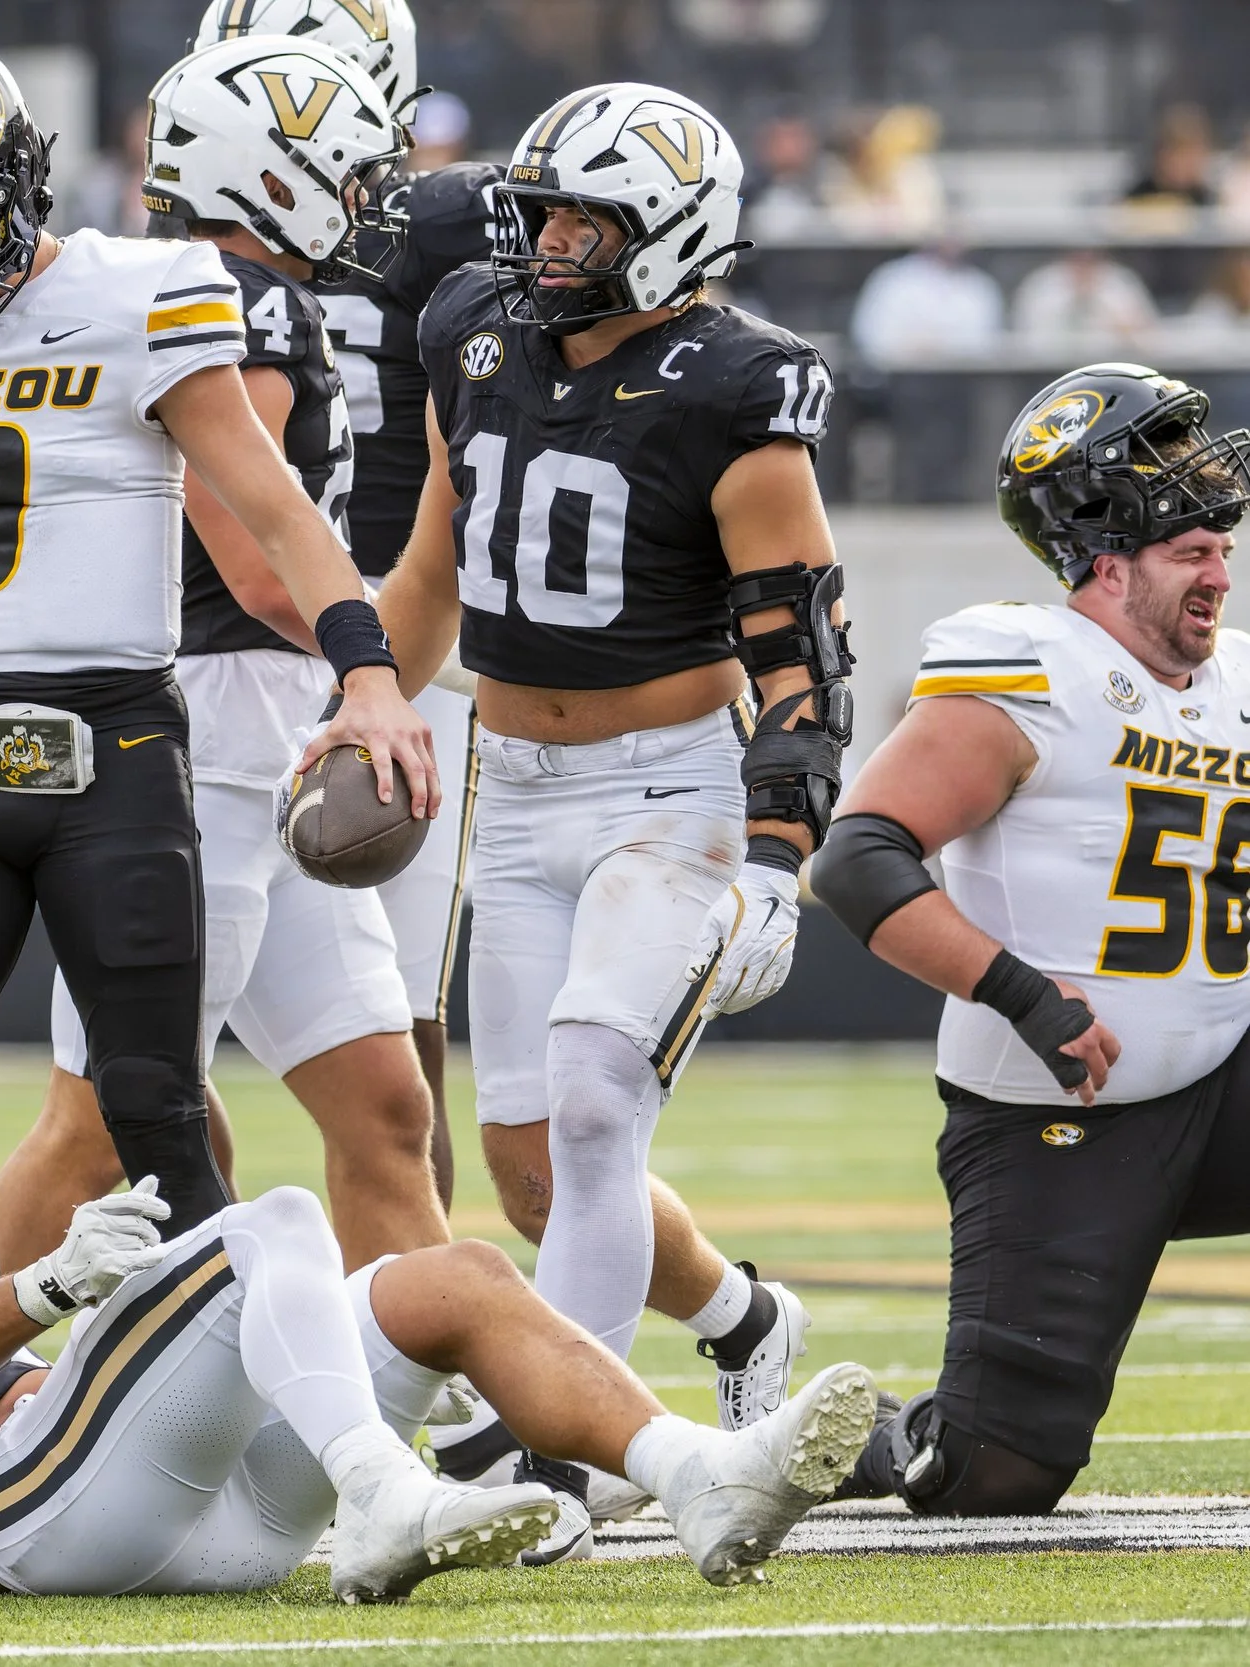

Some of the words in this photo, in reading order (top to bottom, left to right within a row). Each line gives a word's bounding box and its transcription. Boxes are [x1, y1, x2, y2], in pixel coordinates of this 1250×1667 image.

[251, 71, 344, 140] V
[513, 166, 542, 182] VUFB
[626, 117, 704, 186] V
[236, 285, 294, 356] 4
[463, 336, 501, 377] SEC
[658, 341, 704, 380] C
[768, 364, 833, 435] 10
[457, 431, 630, 628] 10
[1095, 782, 1250, 979] 56
